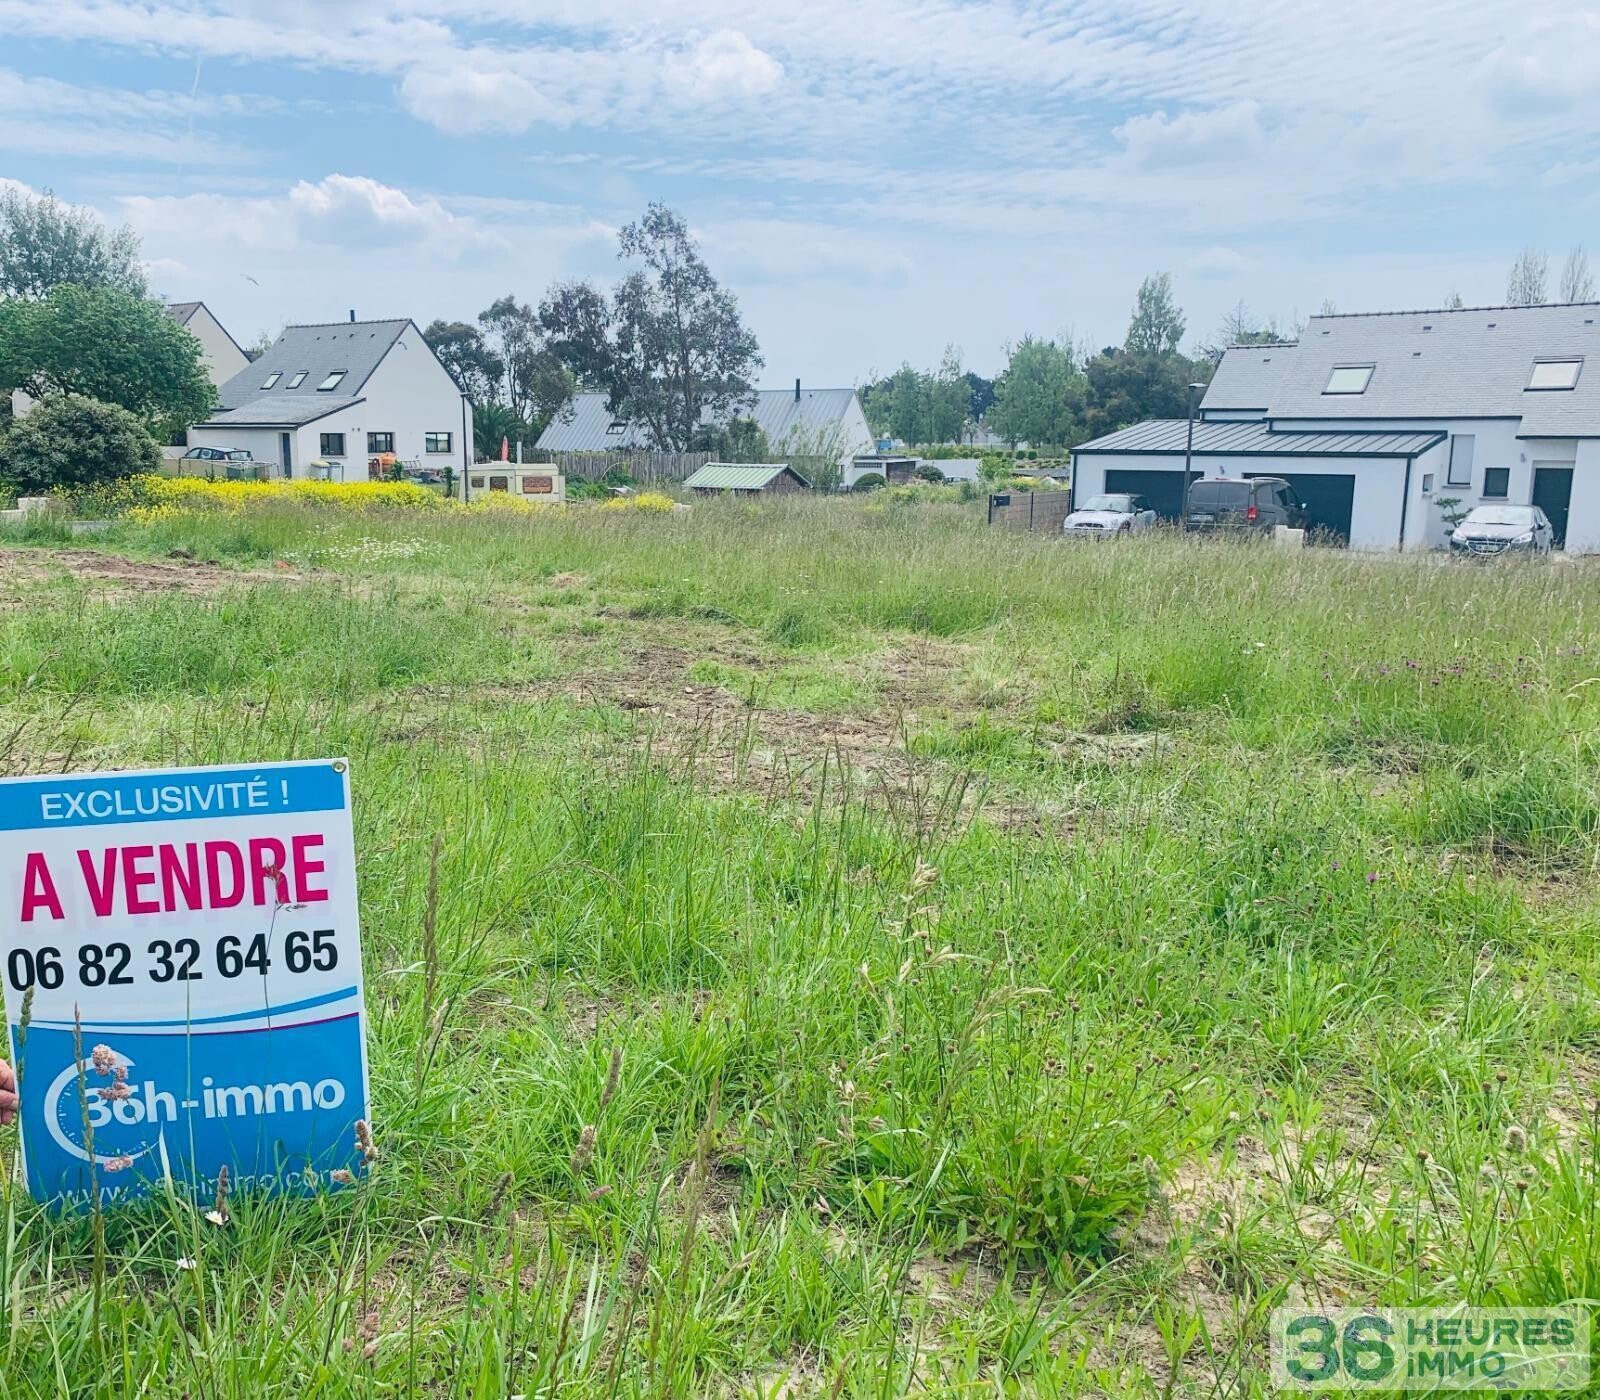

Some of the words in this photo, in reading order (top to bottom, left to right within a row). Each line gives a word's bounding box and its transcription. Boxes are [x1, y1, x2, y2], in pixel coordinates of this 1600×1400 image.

[41, 775, 269, 820] EXCLUSIVITÉ
[280, 779, 289, 805] !
[20, 852, 65, 922] A
[77, 834, 329, 917] VENDRE
[7, 947, 64, 991] 06
[78, 942, 134, 986] 82
[147, 938, 203, 982] 32
[216, 933, 270, 977] 64
[285, 929, 338, 974] 65
